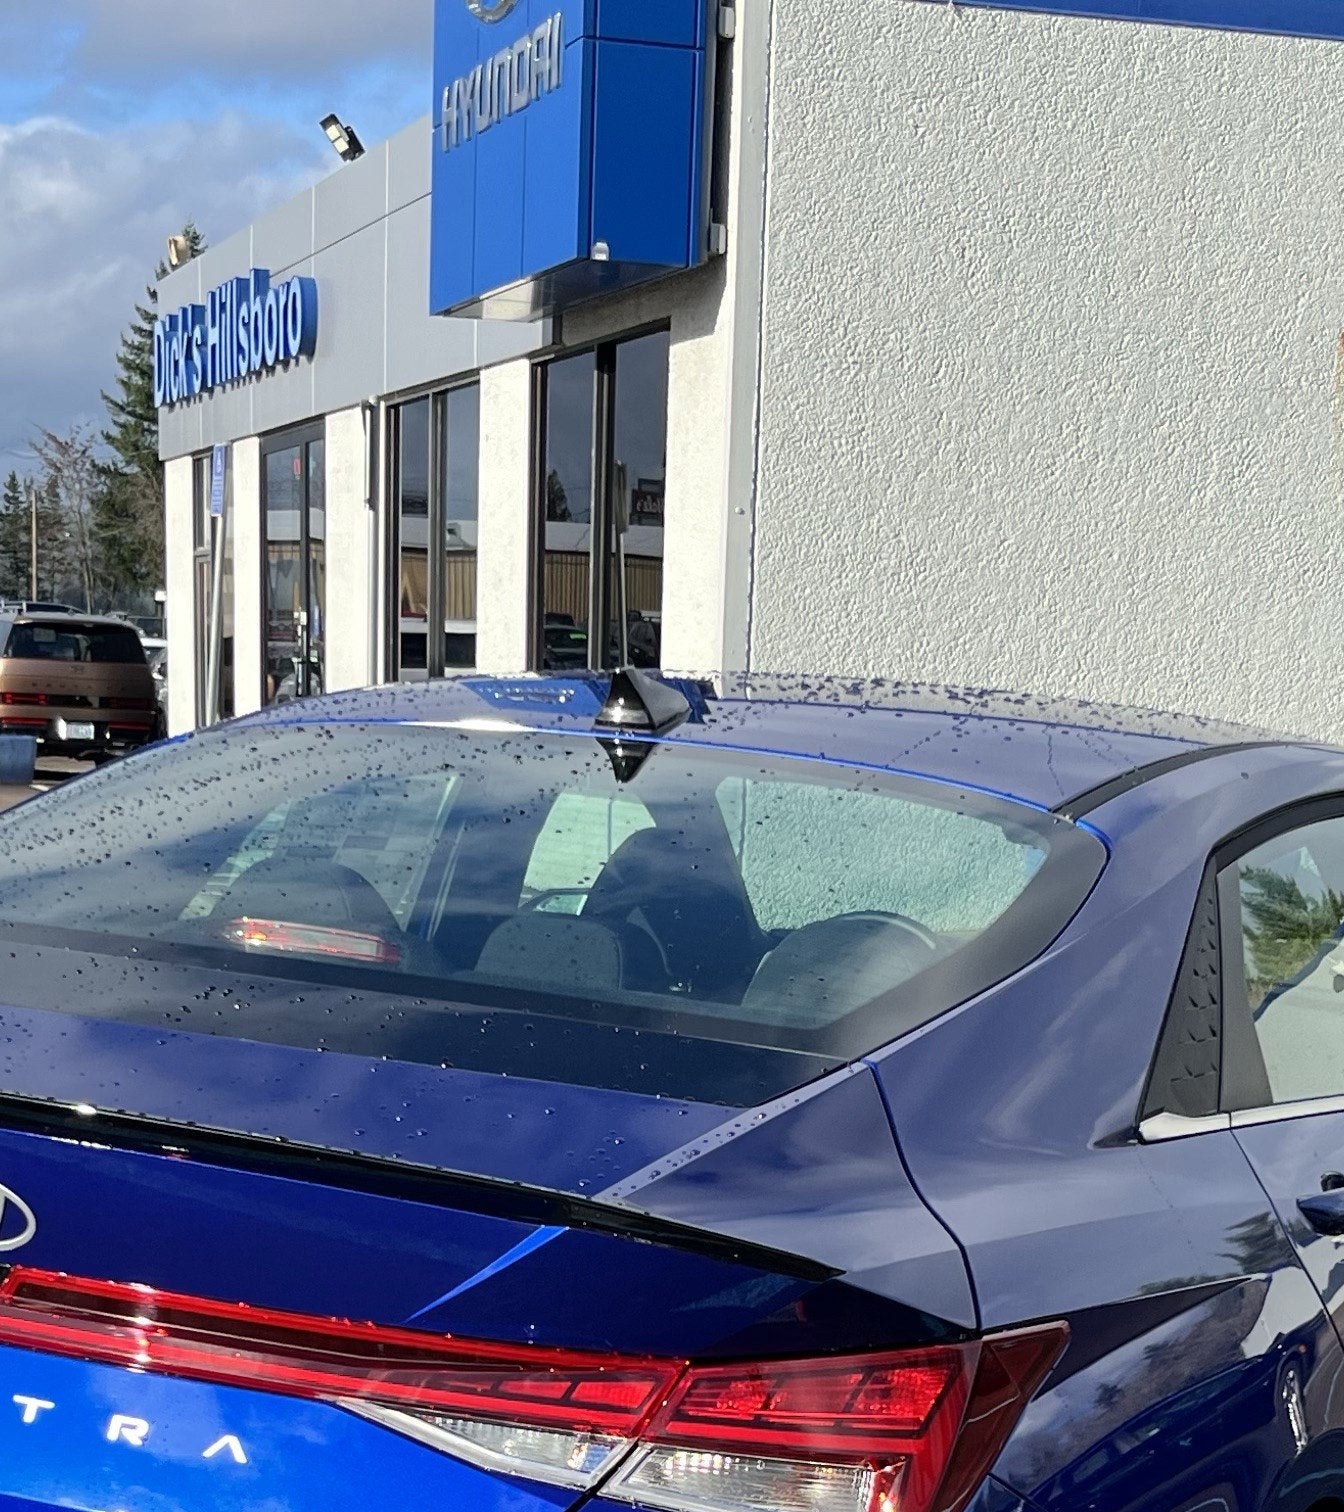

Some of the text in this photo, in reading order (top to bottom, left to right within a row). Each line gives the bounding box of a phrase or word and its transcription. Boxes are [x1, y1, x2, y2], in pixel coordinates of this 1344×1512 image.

[441, 11, 563, 153] HYUNDAI
[153, 268, 309, 408] Dick's Hillsboro
